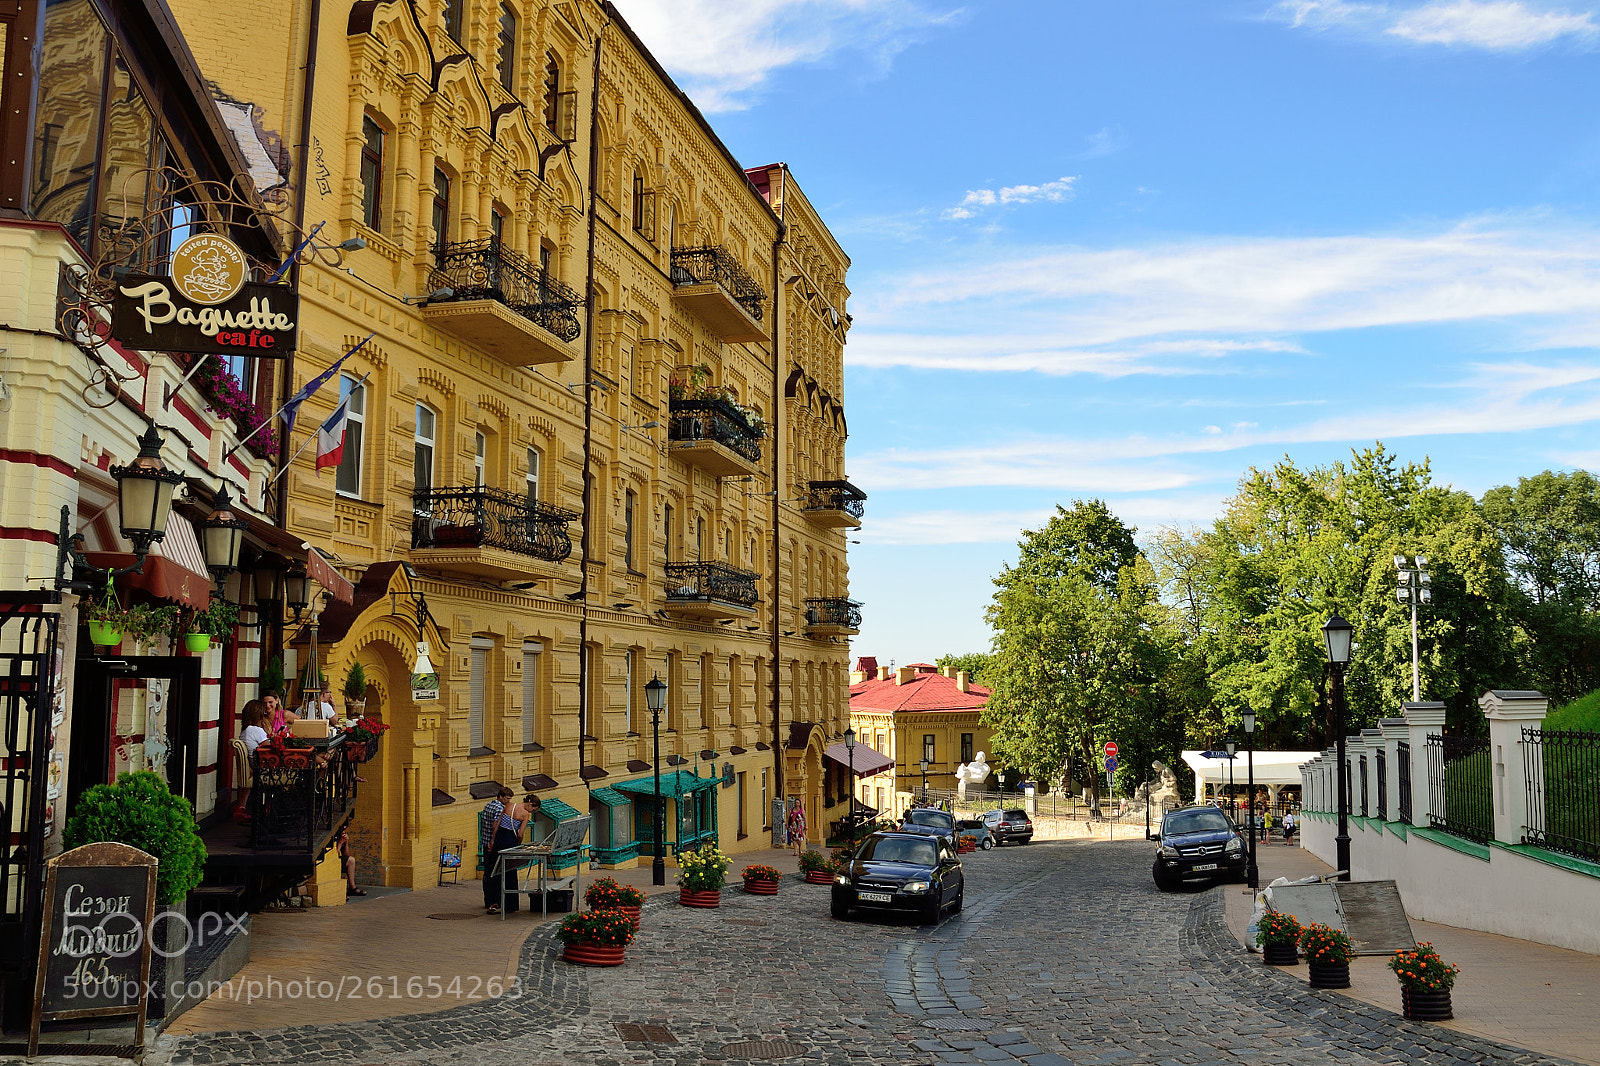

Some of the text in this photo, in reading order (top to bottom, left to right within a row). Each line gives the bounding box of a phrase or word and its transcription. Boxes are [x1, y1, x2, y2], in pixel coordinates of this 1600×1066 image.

[180, 238, 241, 264] tested people!
[119, 281, 295, 337] Baguette
[216, 329, 276, 348] cafe
[64, 883, 131, 917] Сезон
